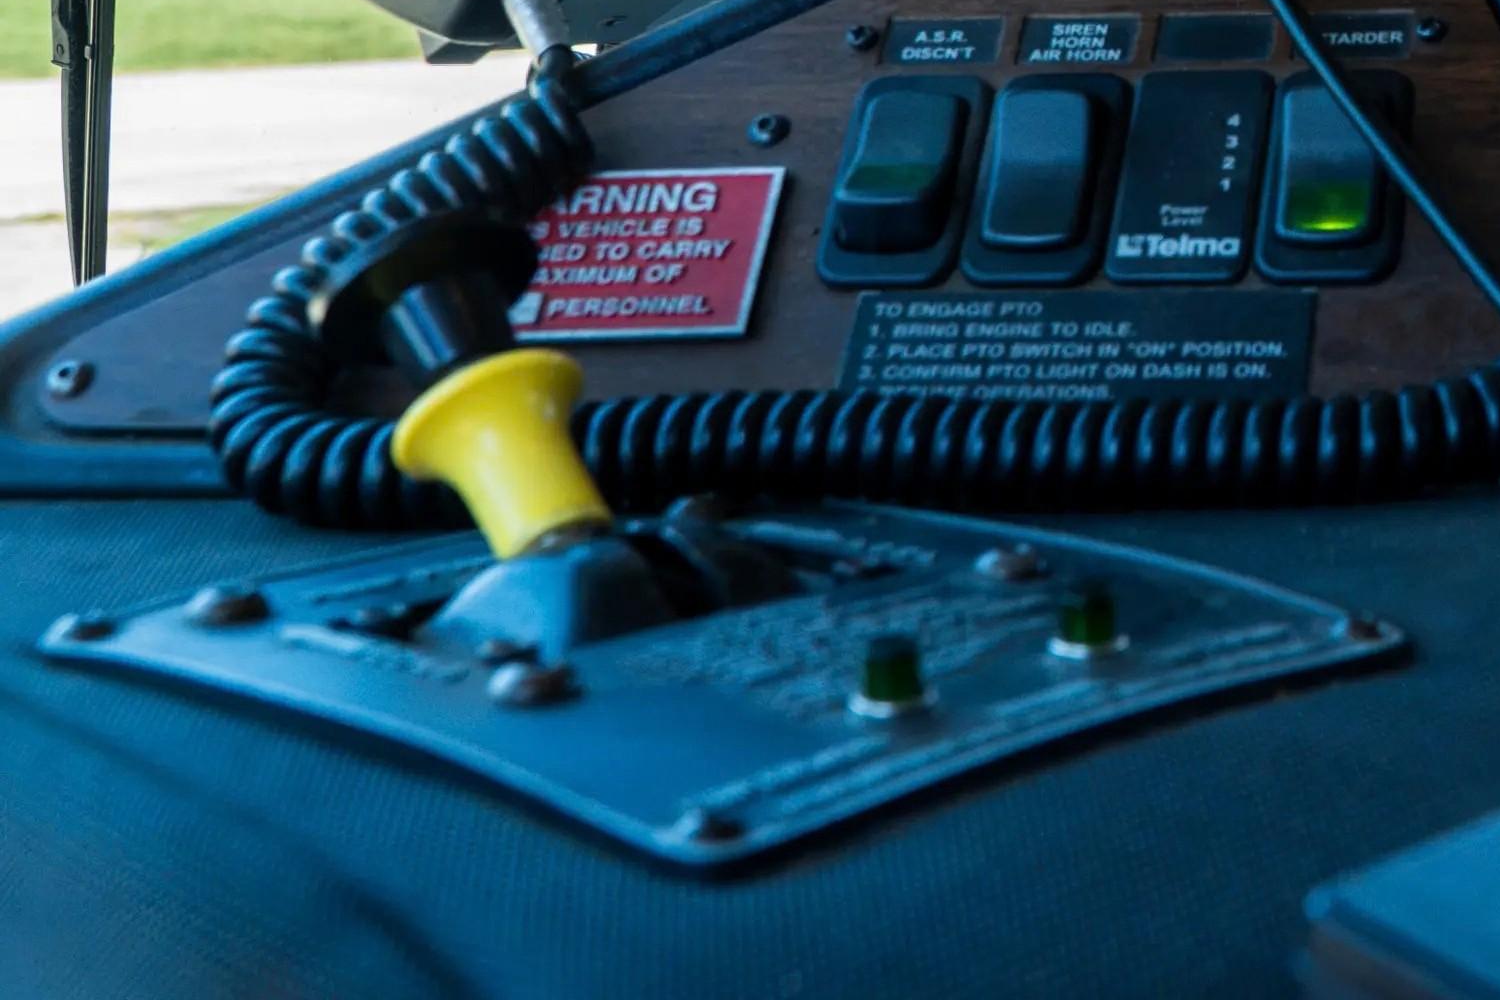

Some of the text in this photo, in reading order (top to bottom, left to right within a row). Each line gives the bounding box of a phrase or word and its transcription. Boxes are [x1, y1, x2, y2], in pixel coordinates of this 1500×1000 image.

[915, 30, 968, 43] A.S.R.
[1052, 23, 1108, 36] SIREN
[1051, 37, 1105, 50] HORN
[1321, 30, 1404, 46] TARDER
[902, 46, 975, 60] DISCN'T
[1029, 48, 1122, 62] AIR HORN
[1227, 112, 1241, 127] 4
[1225, 134, 1239, 149] 3
[1222, 156, 1236, 170] 2
[1219, 177, 1232, 192] 1
[1160, 203, 1209, 216] Power
[558, 219, 671, 238] VEHICLE
[675, 217, 704, 236] IS
[1161, 215, 1204, 227] Level
[597, 242, 630, 261] TO
[636, 239, 731, 260] CARRY
[1147, 232, 1241, 258] Telma
[531, 263, 684, 285] AXIMUM OF
[547, 296, 709, 318] PERSONNEL
[875, 302, 1043, 317] TO ENGAGE PTO
[892, 323, 959, 338] BRING
[964, 323, 1043, 338] ENGINE
[1051, 322, 1080, 337] TO
[1084, 322, 1136, 337] IDLE.
[886, 344, 956, 359] PLACE
[961, 344, 1004, 359] PTO
[1009, 344, 1092, 358] SWITCH
[1098, 343, 1121, 358] IN
[1181, 342, 1288, 358] POSITION.
[882, 365, 981, 380] CONFIRM
[987, 365, 1031, 379] PTO
[1036, 364, 1099, 379] LIGHT
[1104, 364, 1137, 379] ON
[1142, 363, 1201, 378] DASH
[1207, 363, 1228, 378] IS
[1233, 363, 1271, 378] ON.
